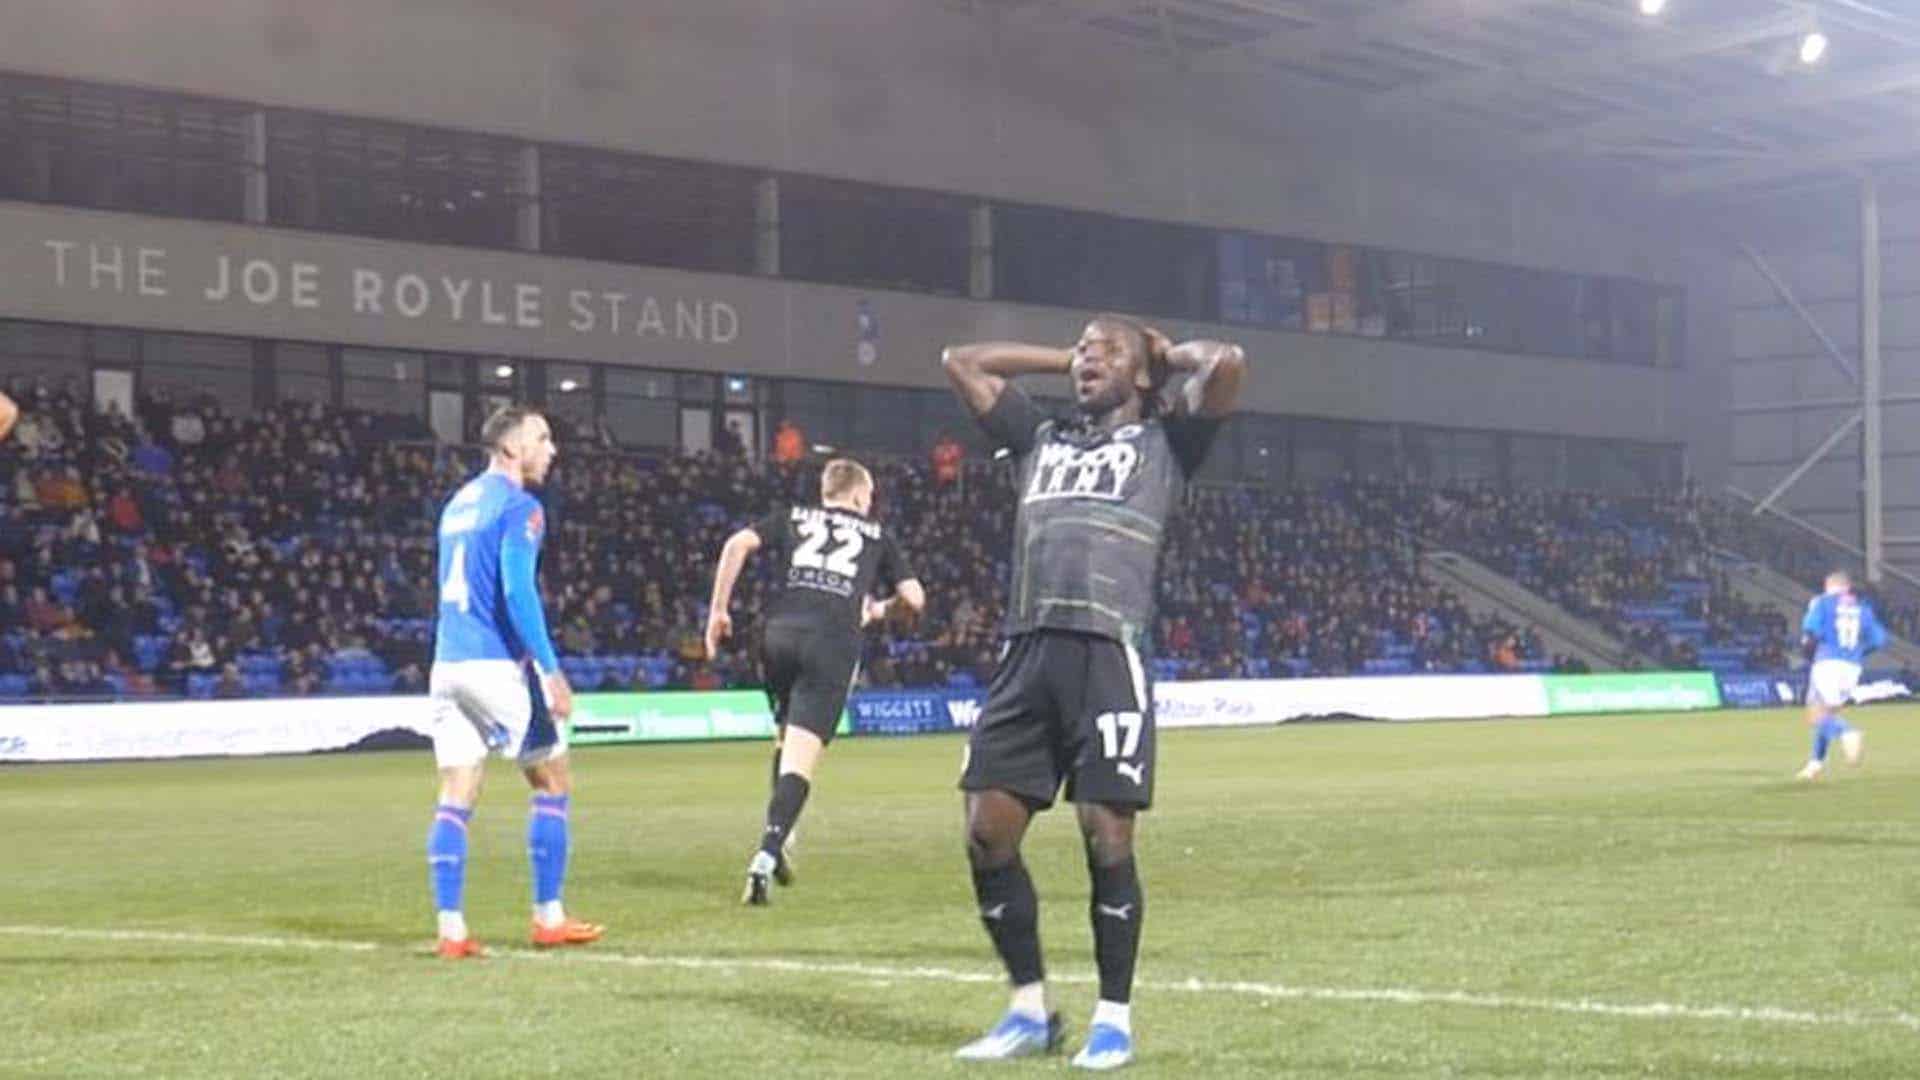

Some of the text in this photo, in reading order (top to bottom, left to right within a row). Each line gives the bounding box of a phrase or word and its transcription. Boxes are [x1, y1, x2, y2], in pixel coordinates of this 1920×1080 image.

[45, 239, 740, 344] THE JOE ROYLE STAND
[791, 518, 863, 578] 22
[1096, 712, 1142, 758] 17
